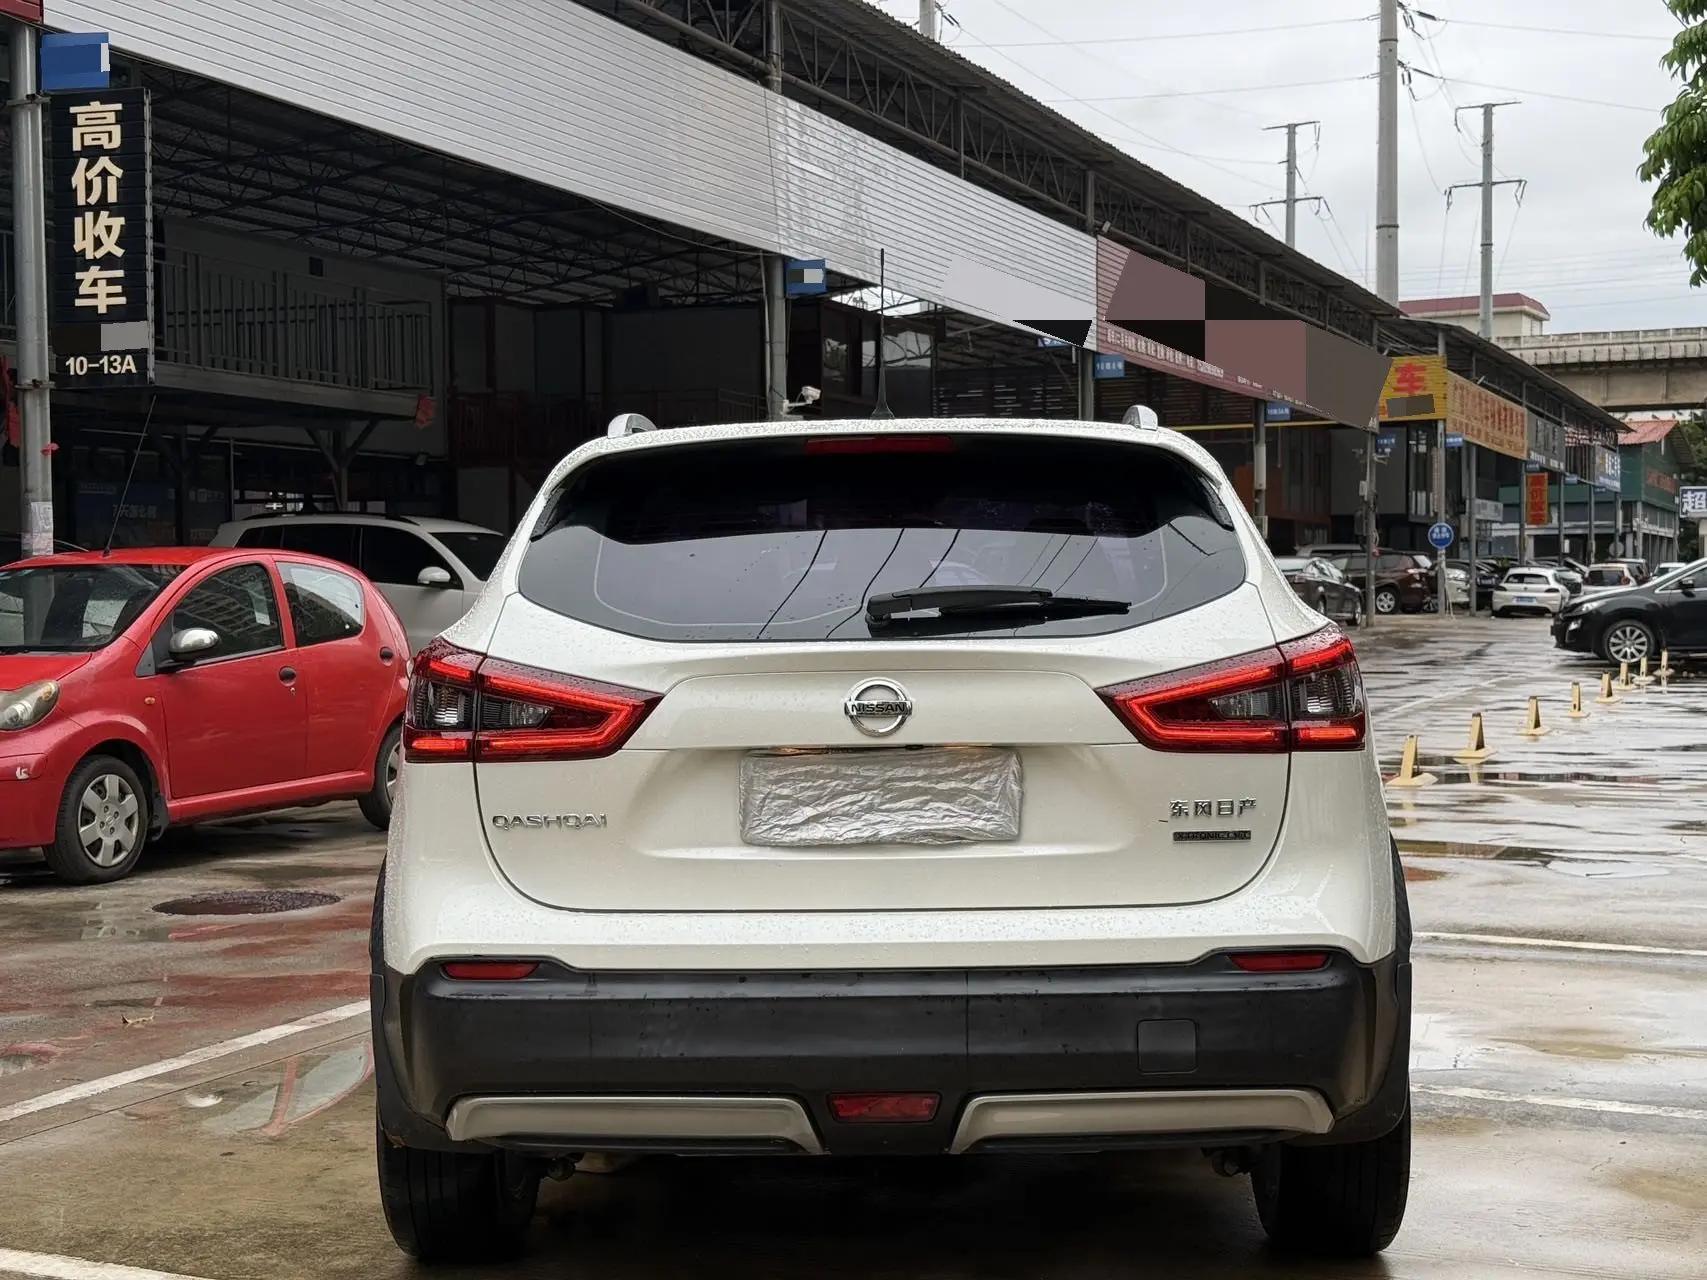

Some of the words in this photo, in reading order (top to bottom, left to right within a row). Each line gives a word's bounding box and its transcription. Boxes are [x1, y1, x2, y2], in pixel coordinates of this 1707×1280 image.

[69, 101, 127, 314] 高价收车
[65, 355, 137, 376] 10-13A
[1392, 362, 1425, 395] 车
[1681, 490, 1707, 514] 超
[851, 703, 906, 713] NISSAN
[1169, 797, 1257, 817] 东风日产
[492, 813, 608, 830] QASHQAI
